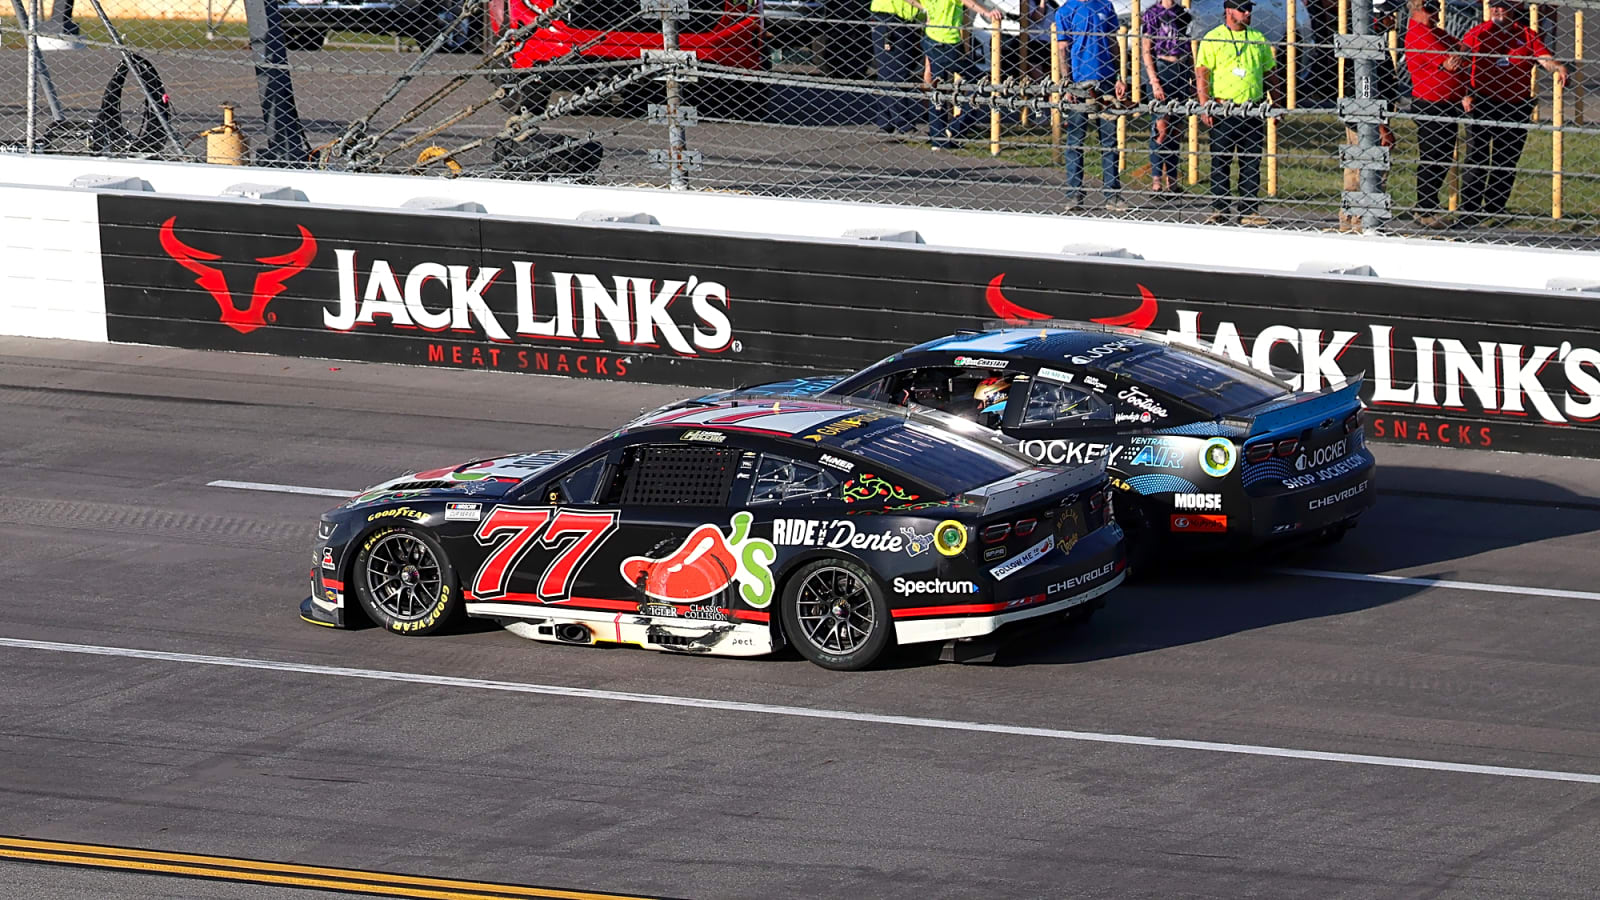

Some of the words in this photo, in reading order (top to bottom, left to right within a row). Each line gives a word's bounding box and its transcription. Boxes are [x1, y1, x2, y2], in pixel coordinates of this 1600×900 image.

[323, 249, 513, 341] JACK
[512, 260, 735, 355] LINK'S
[428, 344, 501, 367] MEAT
[518, 351, 627, 376] SNACKS
[1374, 419, 1492, 446] SNACKS
[1130, 445, 1184, 469] AIR
[1307, 438, 1347, 466] JOCKEY
[1282, 474, 1316, 489] SHOP
[1174, 493, 1222, 509] MOOSE
[1308, 481, 1368, 510] CHEVROLET
[367, 506, 431, 522] GOODYEAR
[773, 519, 816, 547] RIDE
[817, 520, 828, 546] THE
[474, 505, 620, 604] 77
[994, 560, 1023, 577] FOLLOW
[1022, 553, 1033, 563] ME
[893, 577, 974, 597] Spectrum
[1047, 561, 1115, 594] CHEVROLET
[640, 606, 678, 617] IGLER
[684, 611, 729, 621] COLLISION
[689, 604, 723, 614] CLASSIC
